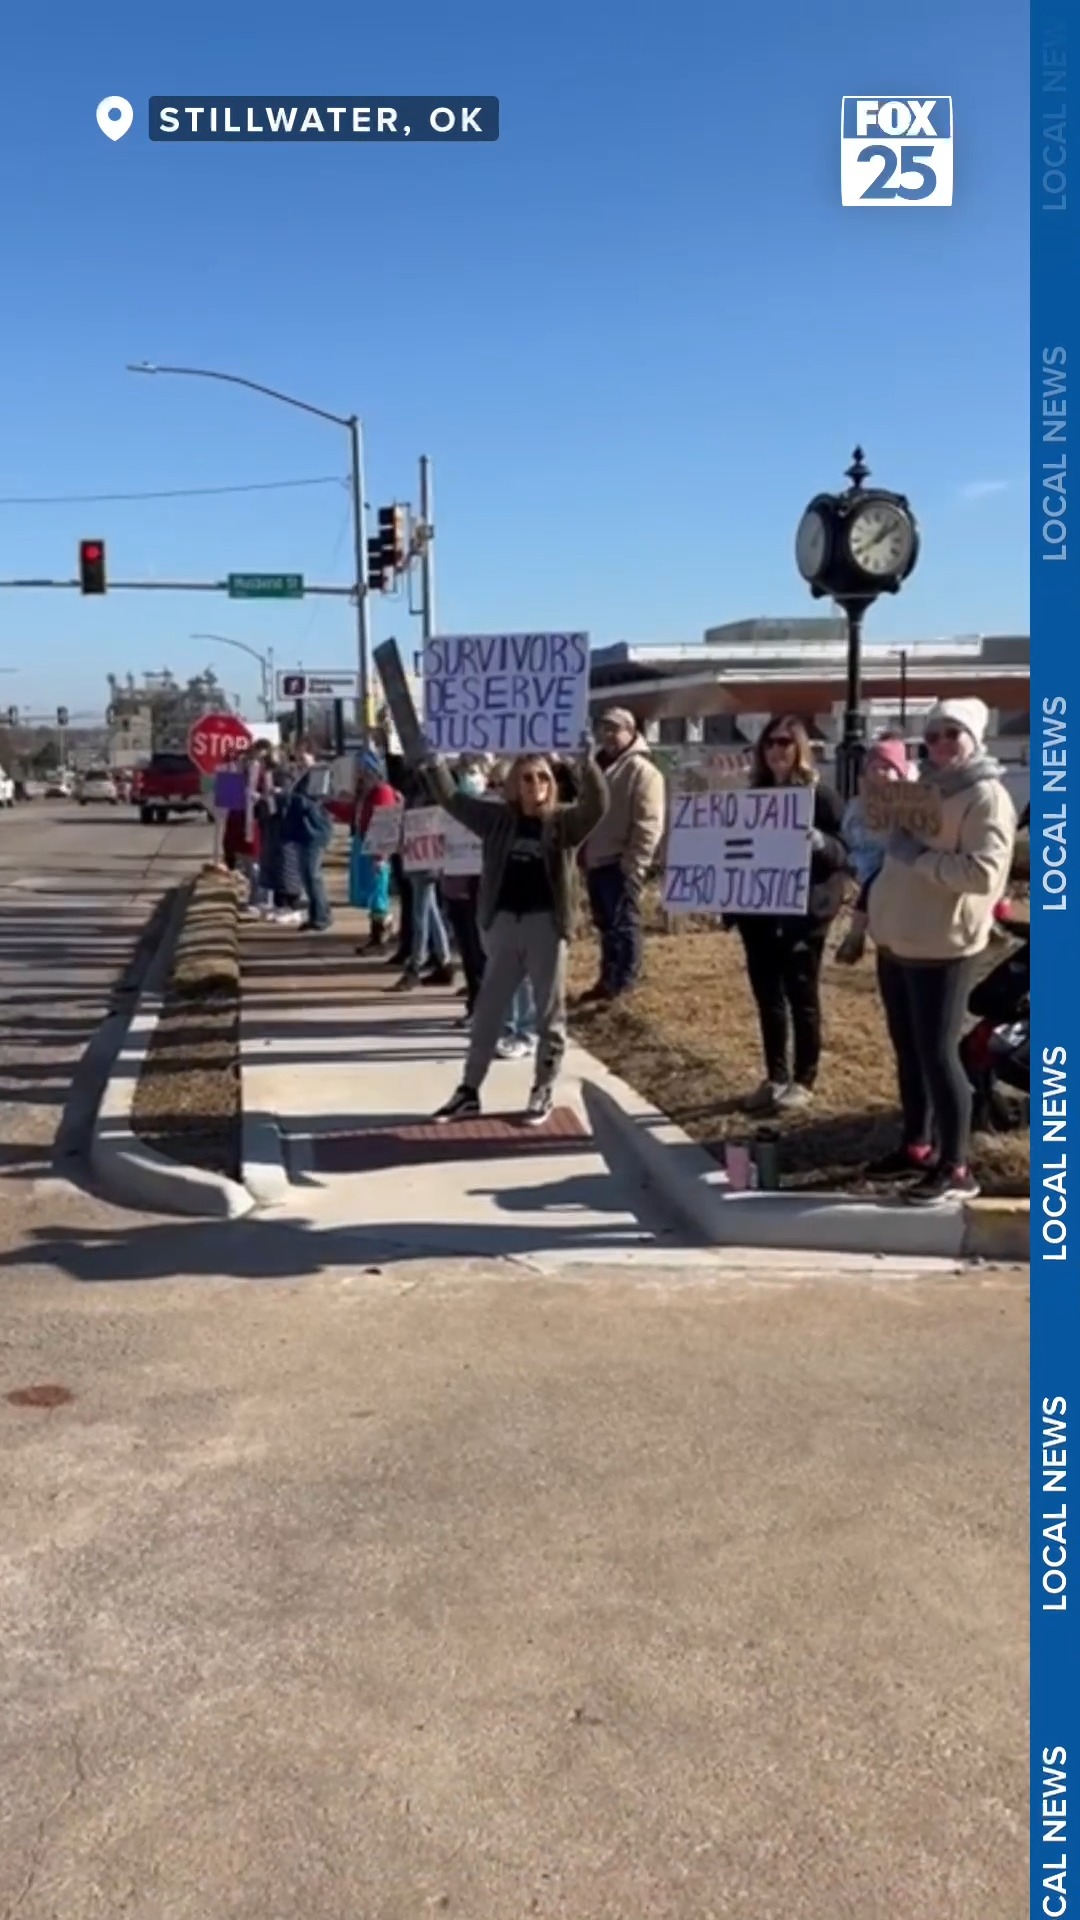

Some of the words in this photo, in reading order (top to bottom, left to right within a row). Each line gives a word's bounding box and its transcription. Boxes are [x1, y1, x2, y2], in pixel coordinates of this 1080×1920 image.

[427, 633, 586, 676] SURVIVORS
[426, 675, 577, 714] DESERVE
[193, 731, 250, 758] STOP
[427, 711, 572, 750] JUSTICE
[674, 792, 739, 829] ZERO
[745, 792, 810, 830] JAIL
[667, 864, 716, 905] ZERO
[720, 866, 808, 910] JUSTICE
